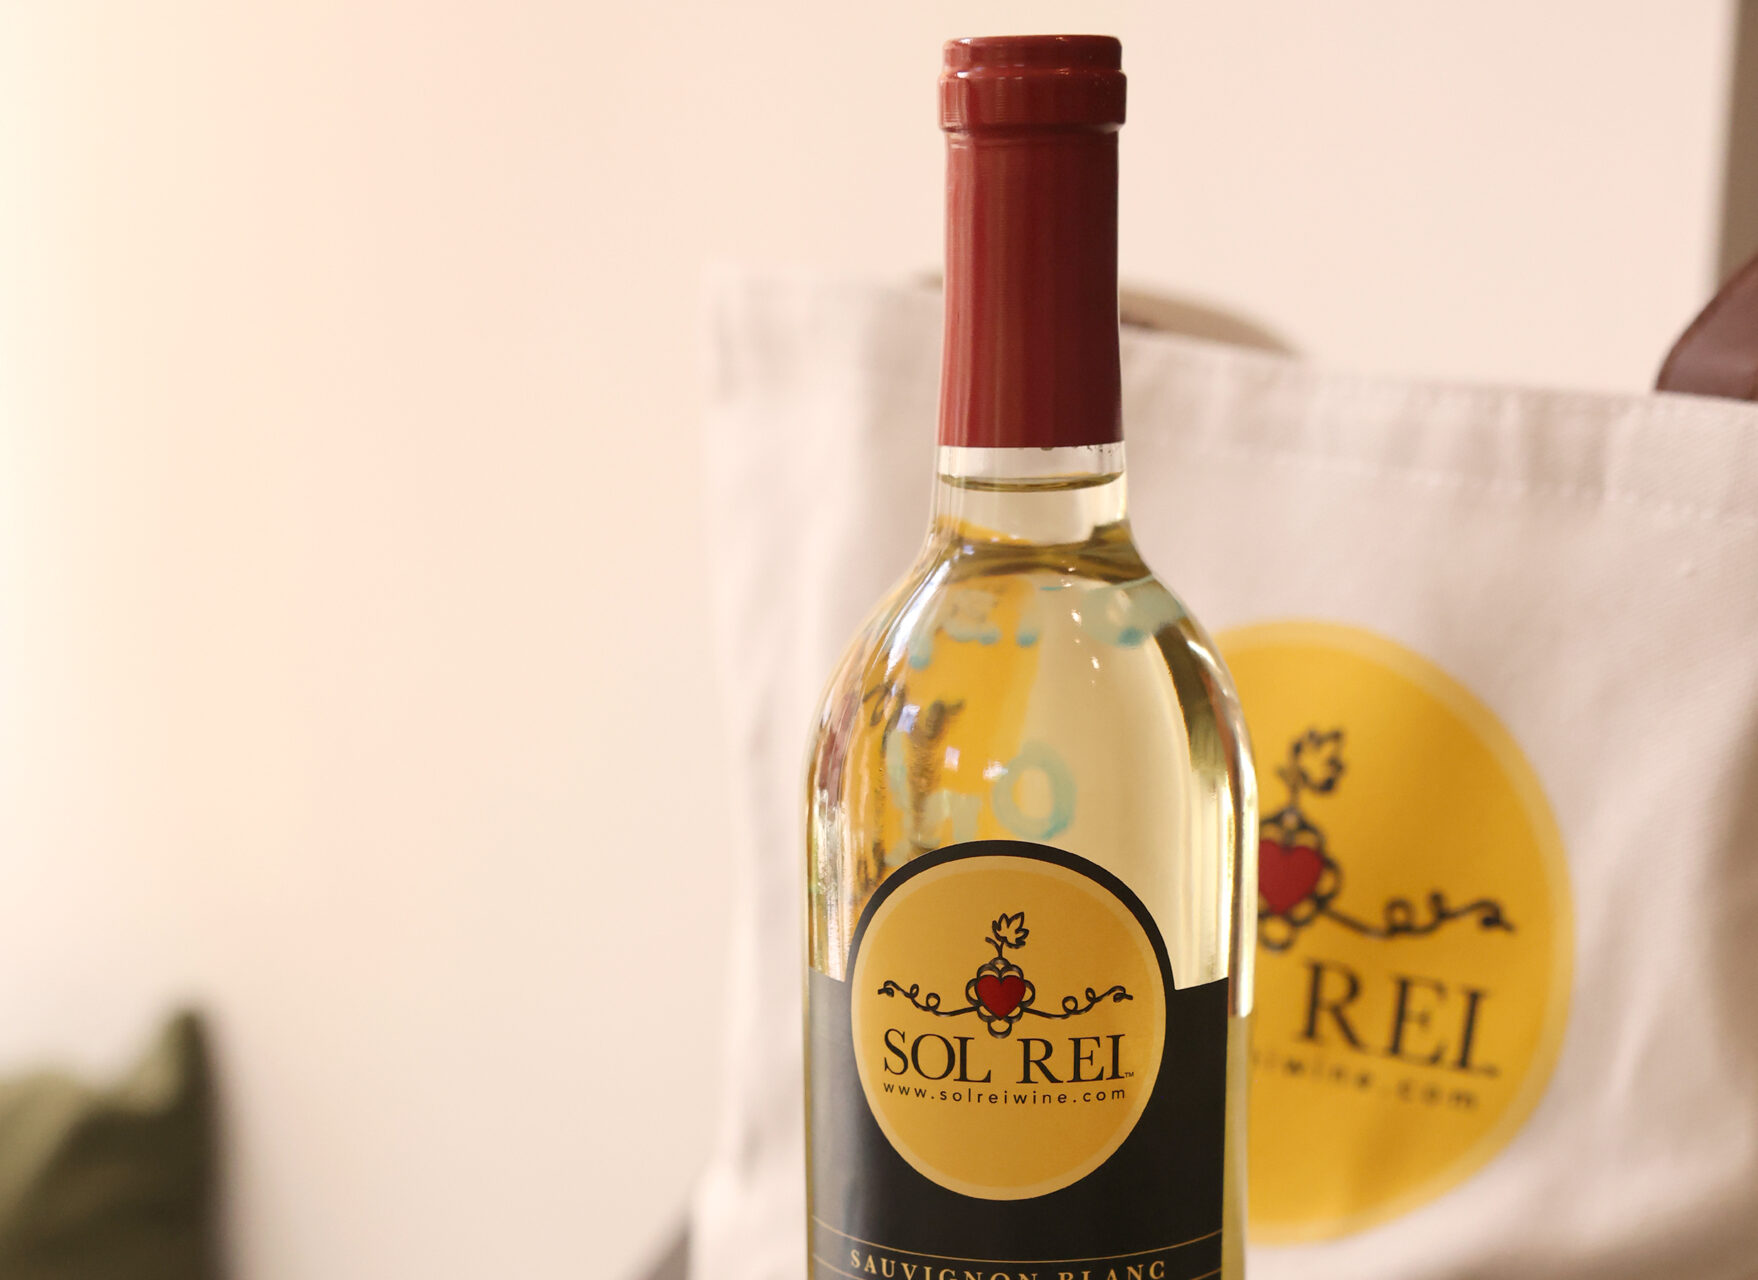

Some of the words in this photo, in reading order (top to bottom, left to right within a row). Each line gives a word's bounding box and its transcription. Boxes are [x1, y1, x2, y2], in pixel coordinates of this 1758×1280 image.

[1298, 957, 1490, 1072] REI
[883, 1027, 992, 1084] SOL
[883, 1082, 1126, 1105] www.solreiwine.com
